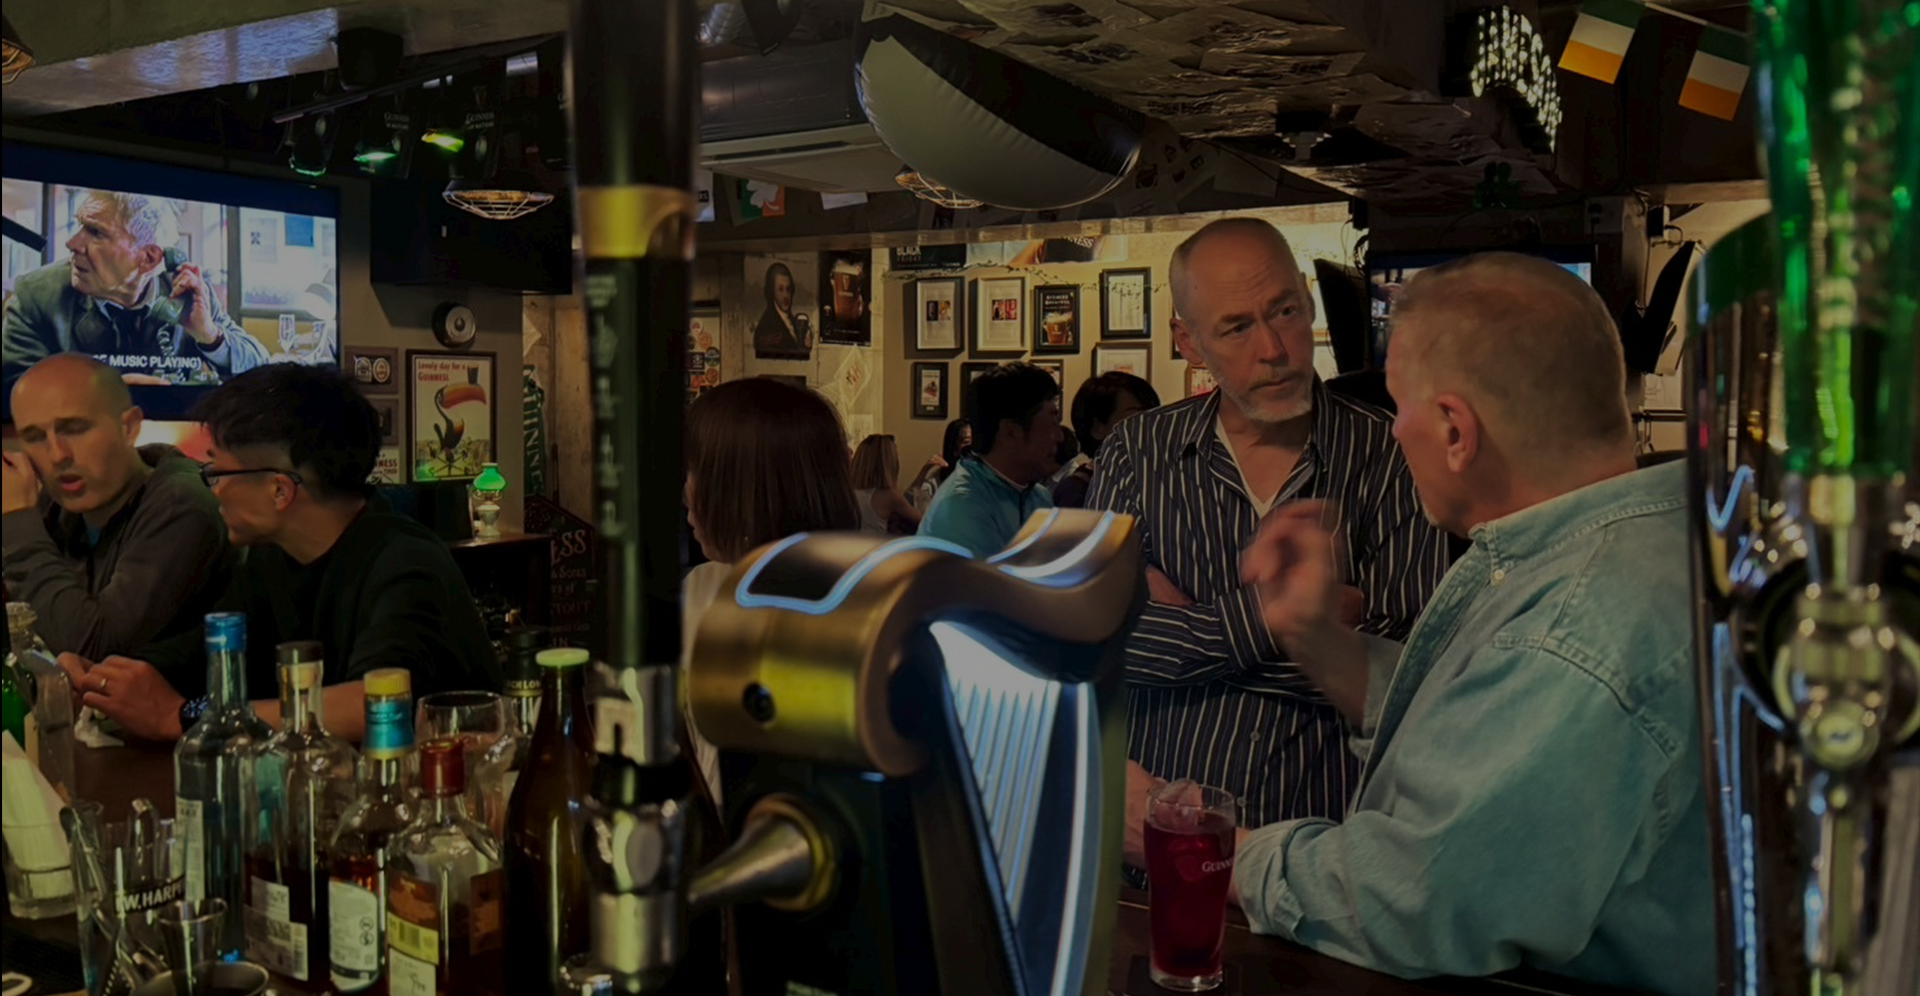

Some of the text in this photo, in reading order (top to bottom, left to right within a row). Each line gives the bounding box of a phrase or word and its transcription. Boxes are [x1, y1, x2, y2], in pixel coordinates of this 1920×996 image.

[109, 354, 148, 368] MUSIC
[149, 356, 202, 371] PLAYING)
[418, 361, 437, 372] Lovely
[439, 362, 450, 372] day
[452, 362, 461, 371] for
[418, 371, 449, 382] GUINNESS
[550, 529, 587, 565] ESS
